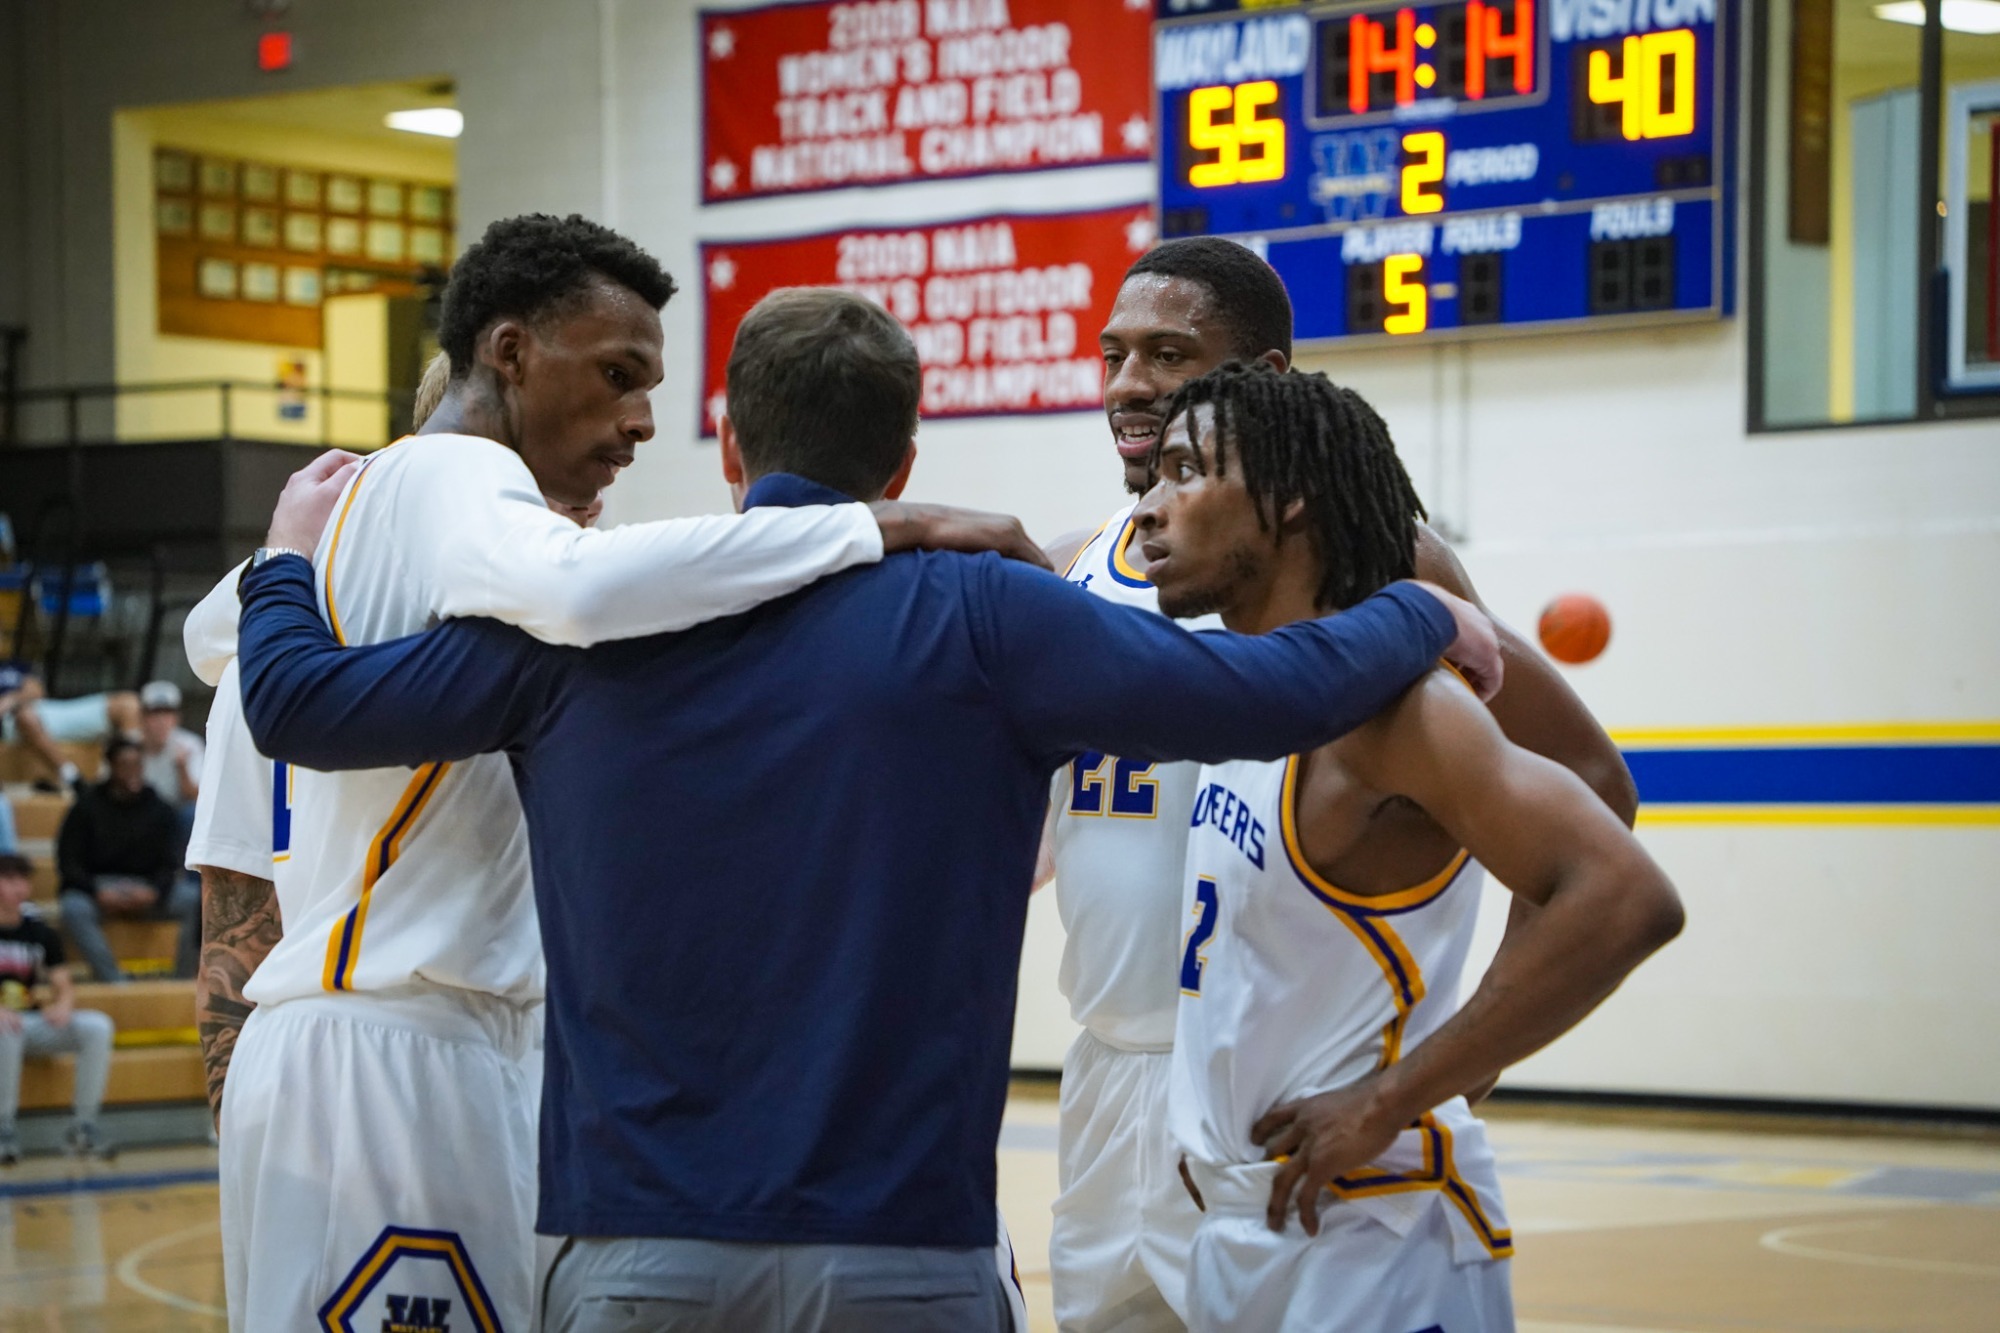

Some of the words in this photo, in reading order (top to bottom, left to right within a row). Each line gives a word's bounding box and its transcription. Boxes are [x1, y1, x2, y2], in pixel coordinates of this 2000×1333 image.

[1550, 0, 1716, 42] VISITOR
[777, 38, 931, 95] WOMEN'S
[937, 22, 1071, 78] INDOOR
[1155, 13, 1310, 91] WAYLAND
[776, 89, 888, 140] TRACK
[894, 80, 968, 128] AND
[972, 68, 1081, 121] FIELD
[1589, 28, 1695, 141] 40
[750, 134, 912, 188] NATIONAL
[919, 112, 1103, 172] CHAMPION
[1189, 80, 1285, 188] 55
[1401, 131, 1445, 214] 2
[1446, 143, 1539, 187] PERIOD
[1341, 220, 1435, 264] PLAYER
[1440, 211, 1522, 255] FOULS
[1590, 196, 1675, 243] FOULS
[836, 231, 927, 280] 2009
[932, 221, 1017, 272] NAIA
[924, 262, 1092, 320] OUTDOOR
[910, 318, 963, 366] ND
[967, 311, 1077, 361] FIELD
[922, 356, 1103, 412] CHAMPION
